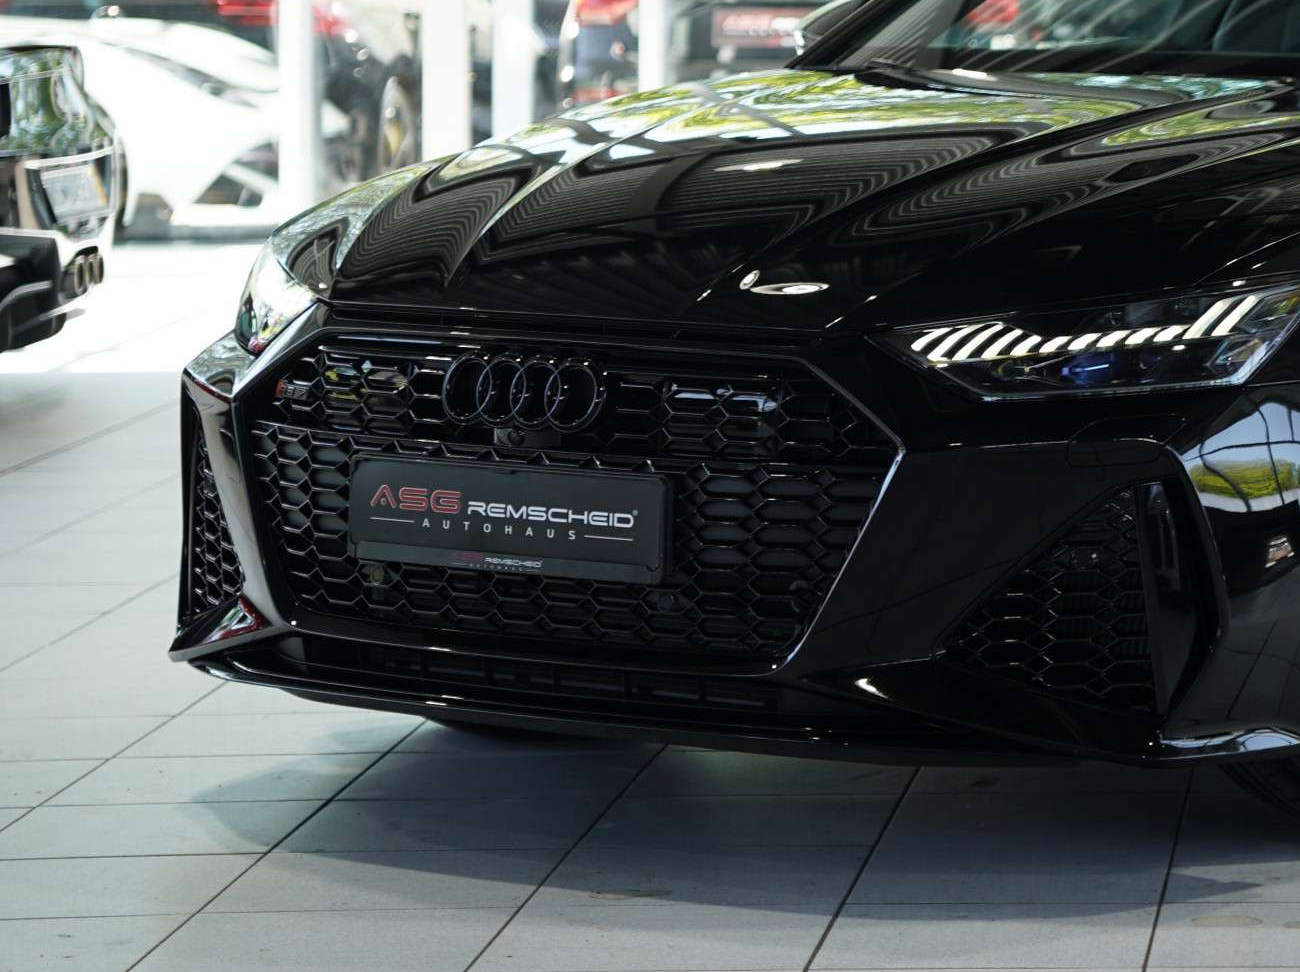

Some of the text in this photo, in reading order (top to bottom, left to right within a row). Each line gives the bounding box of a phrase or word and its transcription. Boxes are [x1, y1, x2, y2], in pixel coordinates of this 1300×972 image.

[370, 484, 635, 528] ASG REMSCHEID
[422, 517, 577, 541] AUTOHAUS
